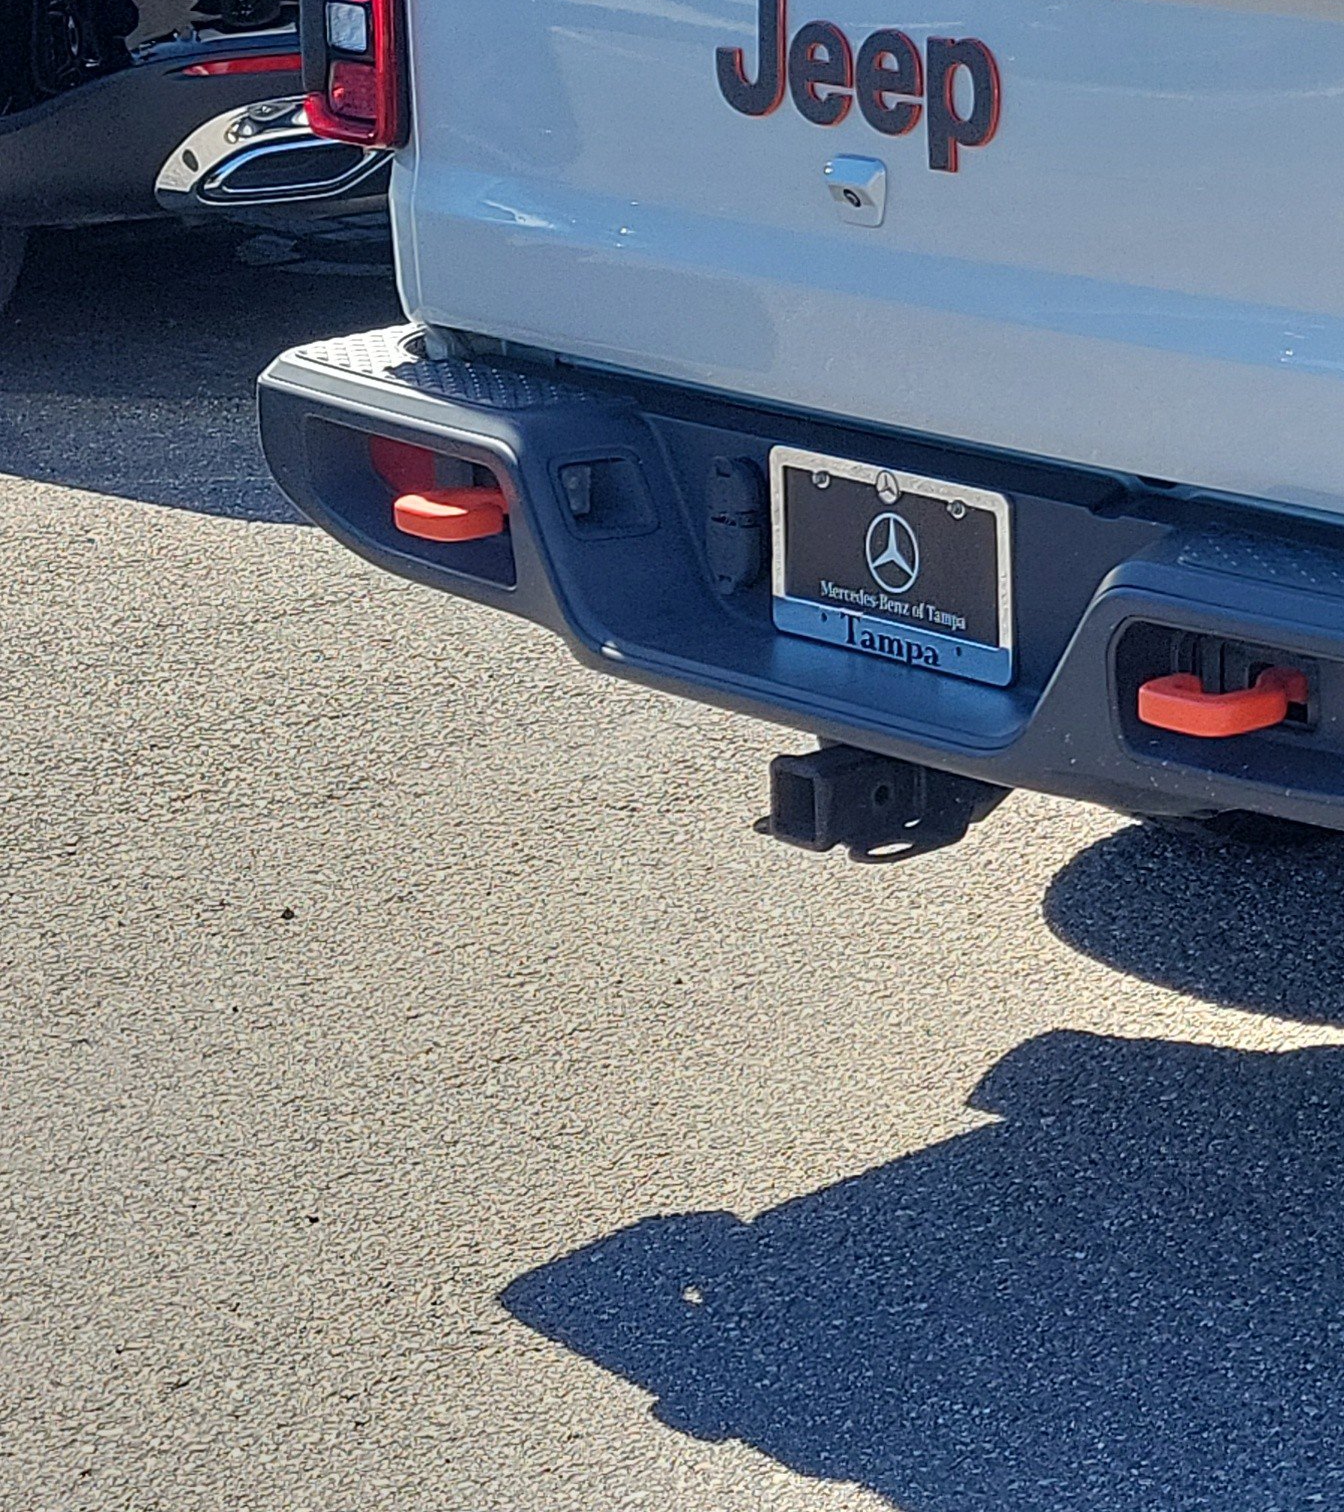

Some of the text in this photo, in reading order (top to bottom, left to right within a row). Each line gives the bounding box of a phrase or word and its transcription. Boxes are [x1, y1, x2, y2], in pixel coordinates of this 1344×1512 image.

[820, 580, 967, 631] Mercedes-Benz of Tampa
[839, 609, 942, 667] Tampa
